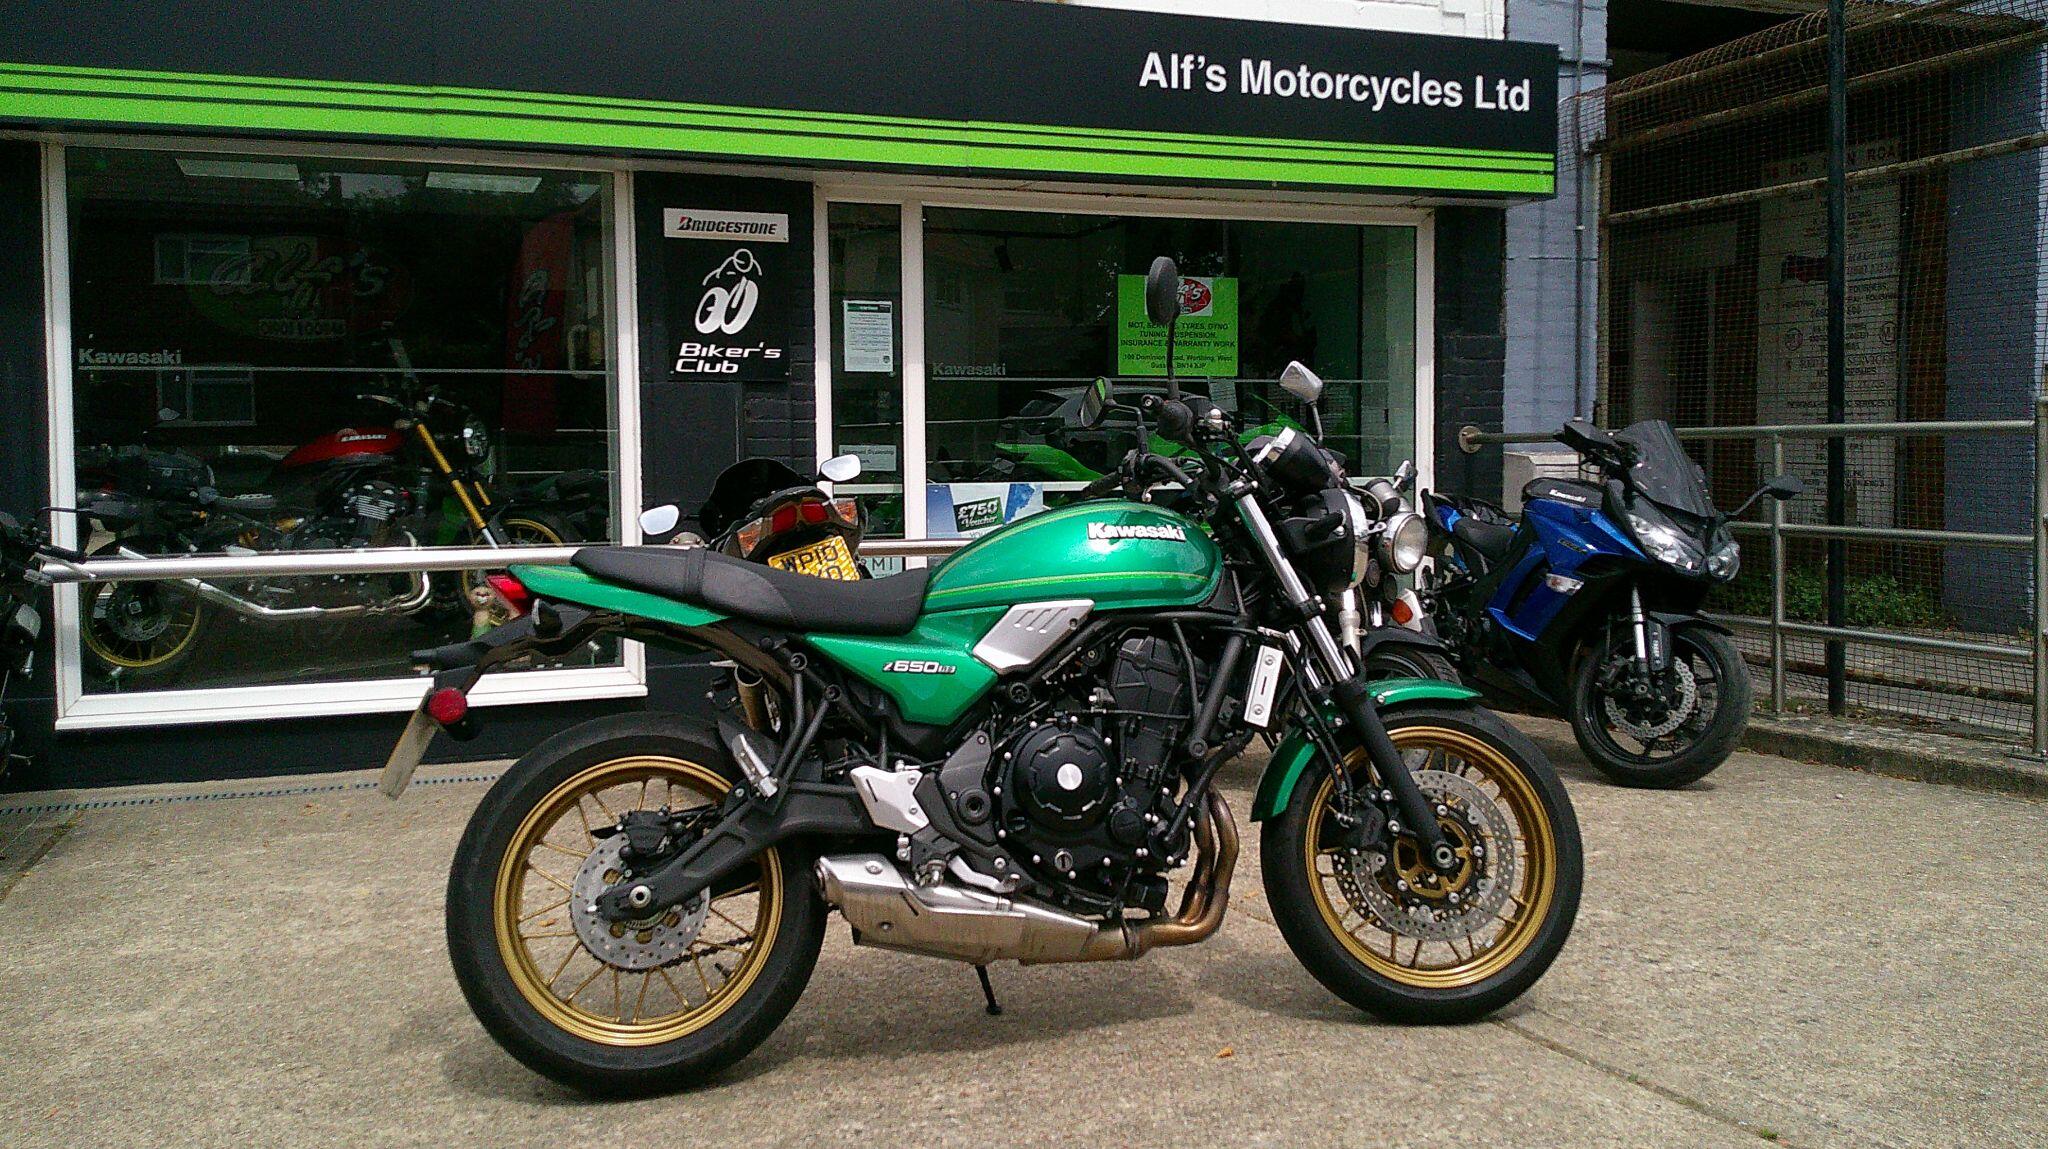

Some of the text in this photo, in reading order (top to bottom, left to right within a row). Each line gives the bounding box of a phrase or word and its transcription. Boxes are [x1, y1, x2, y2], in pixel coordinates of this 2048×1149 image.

[1138, 51, 1532, 112] Alf's Motorcycles Ltd
[678, 216, 778, 235] BRIDGESTONE
[679, 341, 782, 359] Biker's
[1120, 339, 1163, 348] INSURANCE
[79, 347, 182, 365] Kawasaki
[675, 359, 739, 374] Club
[932, 362, 1006, 376] Kawasaki
[957, 500, 998, 520] £750
[961, 515, 998, 528] Voucher
[1088, 522, 1187, 541] Kawasaki
